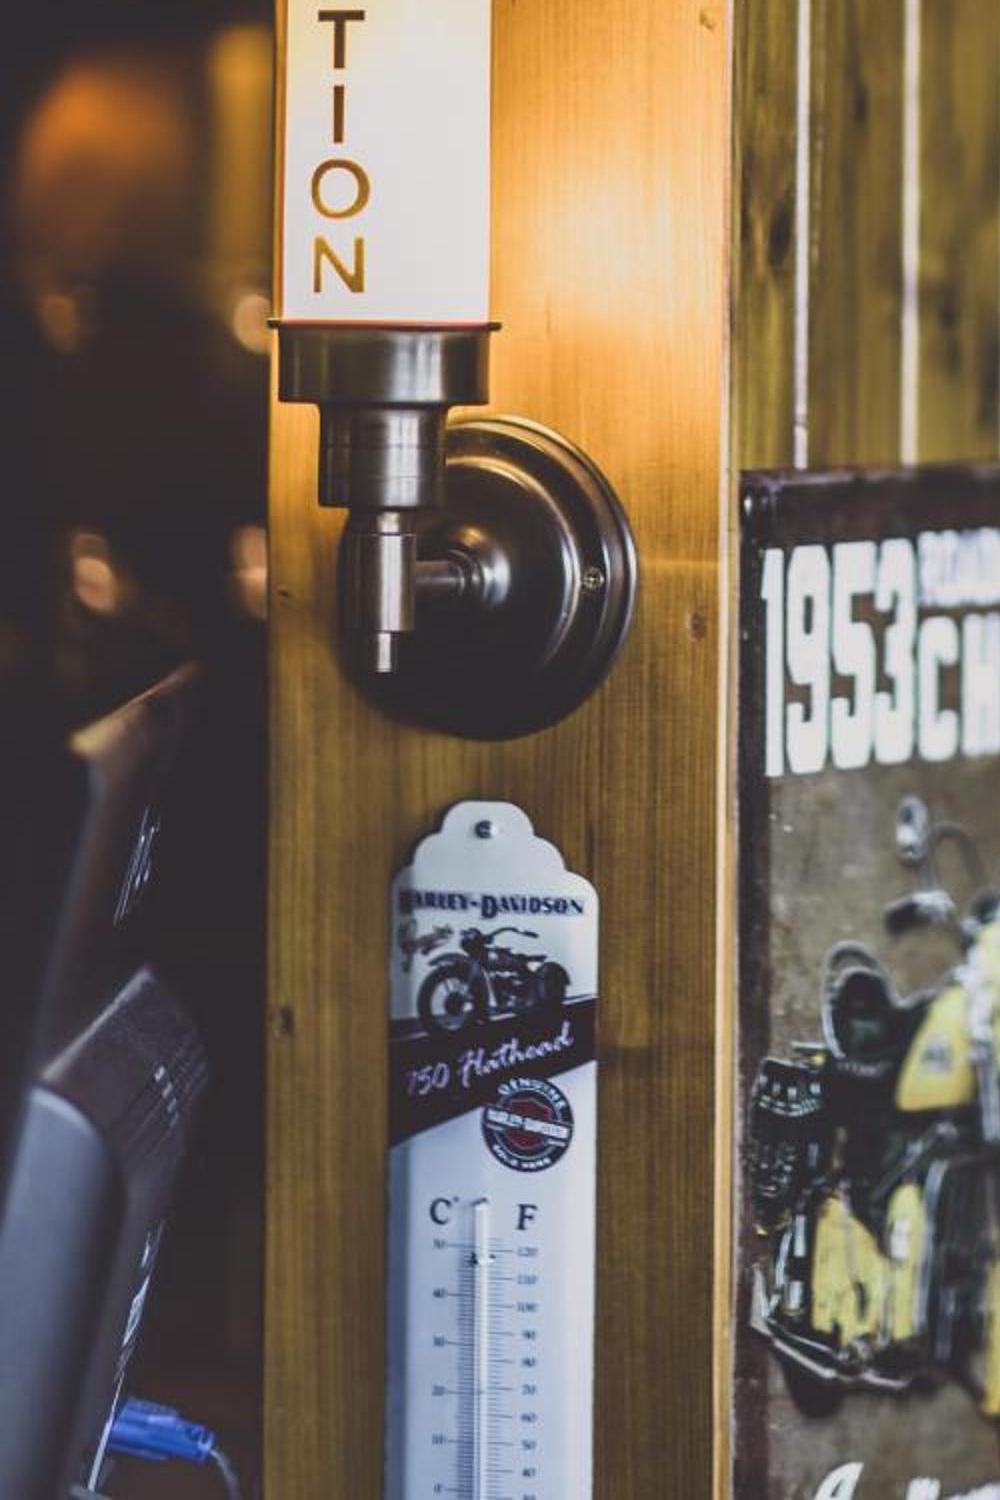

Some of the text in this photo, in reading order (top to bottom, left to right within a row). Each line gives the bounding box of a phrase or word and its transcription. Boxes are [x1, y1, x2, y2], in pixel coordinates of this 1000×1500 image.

[761, 538, 916, 778] 1953
[406, 1019, 575, 1096] 750 Flathead
[516, 1203, 538, 1231] F
